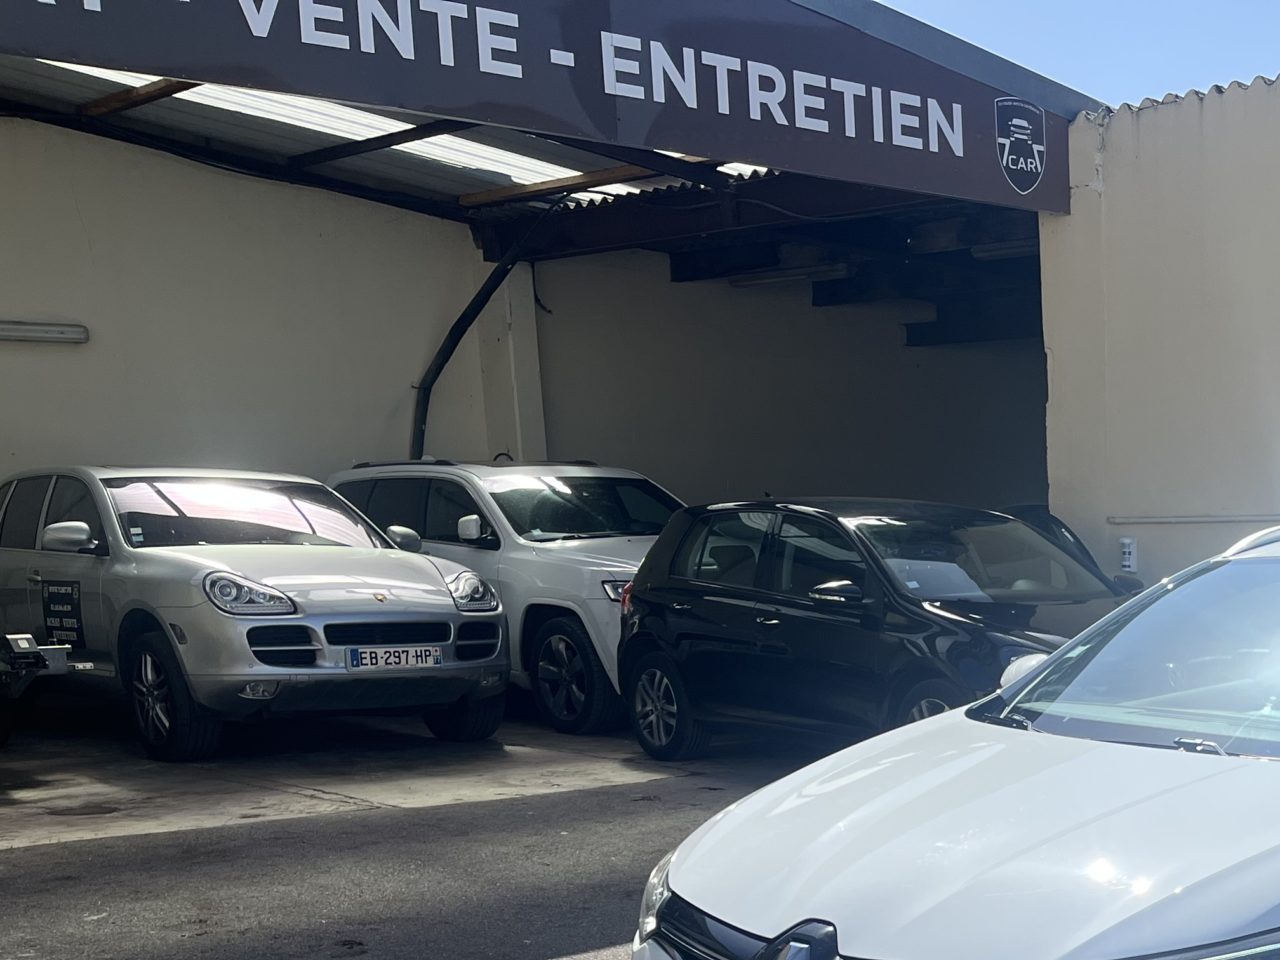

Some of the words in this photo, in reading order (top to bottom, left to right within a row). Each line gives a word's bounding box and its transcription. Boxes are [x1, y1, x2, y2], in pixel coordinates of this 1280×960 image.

[239, 0, 523, 79] VENTE
[600, 31, 964, 158] ENTRETIEN
[359, 649, 432, 666] EB-297-HP
